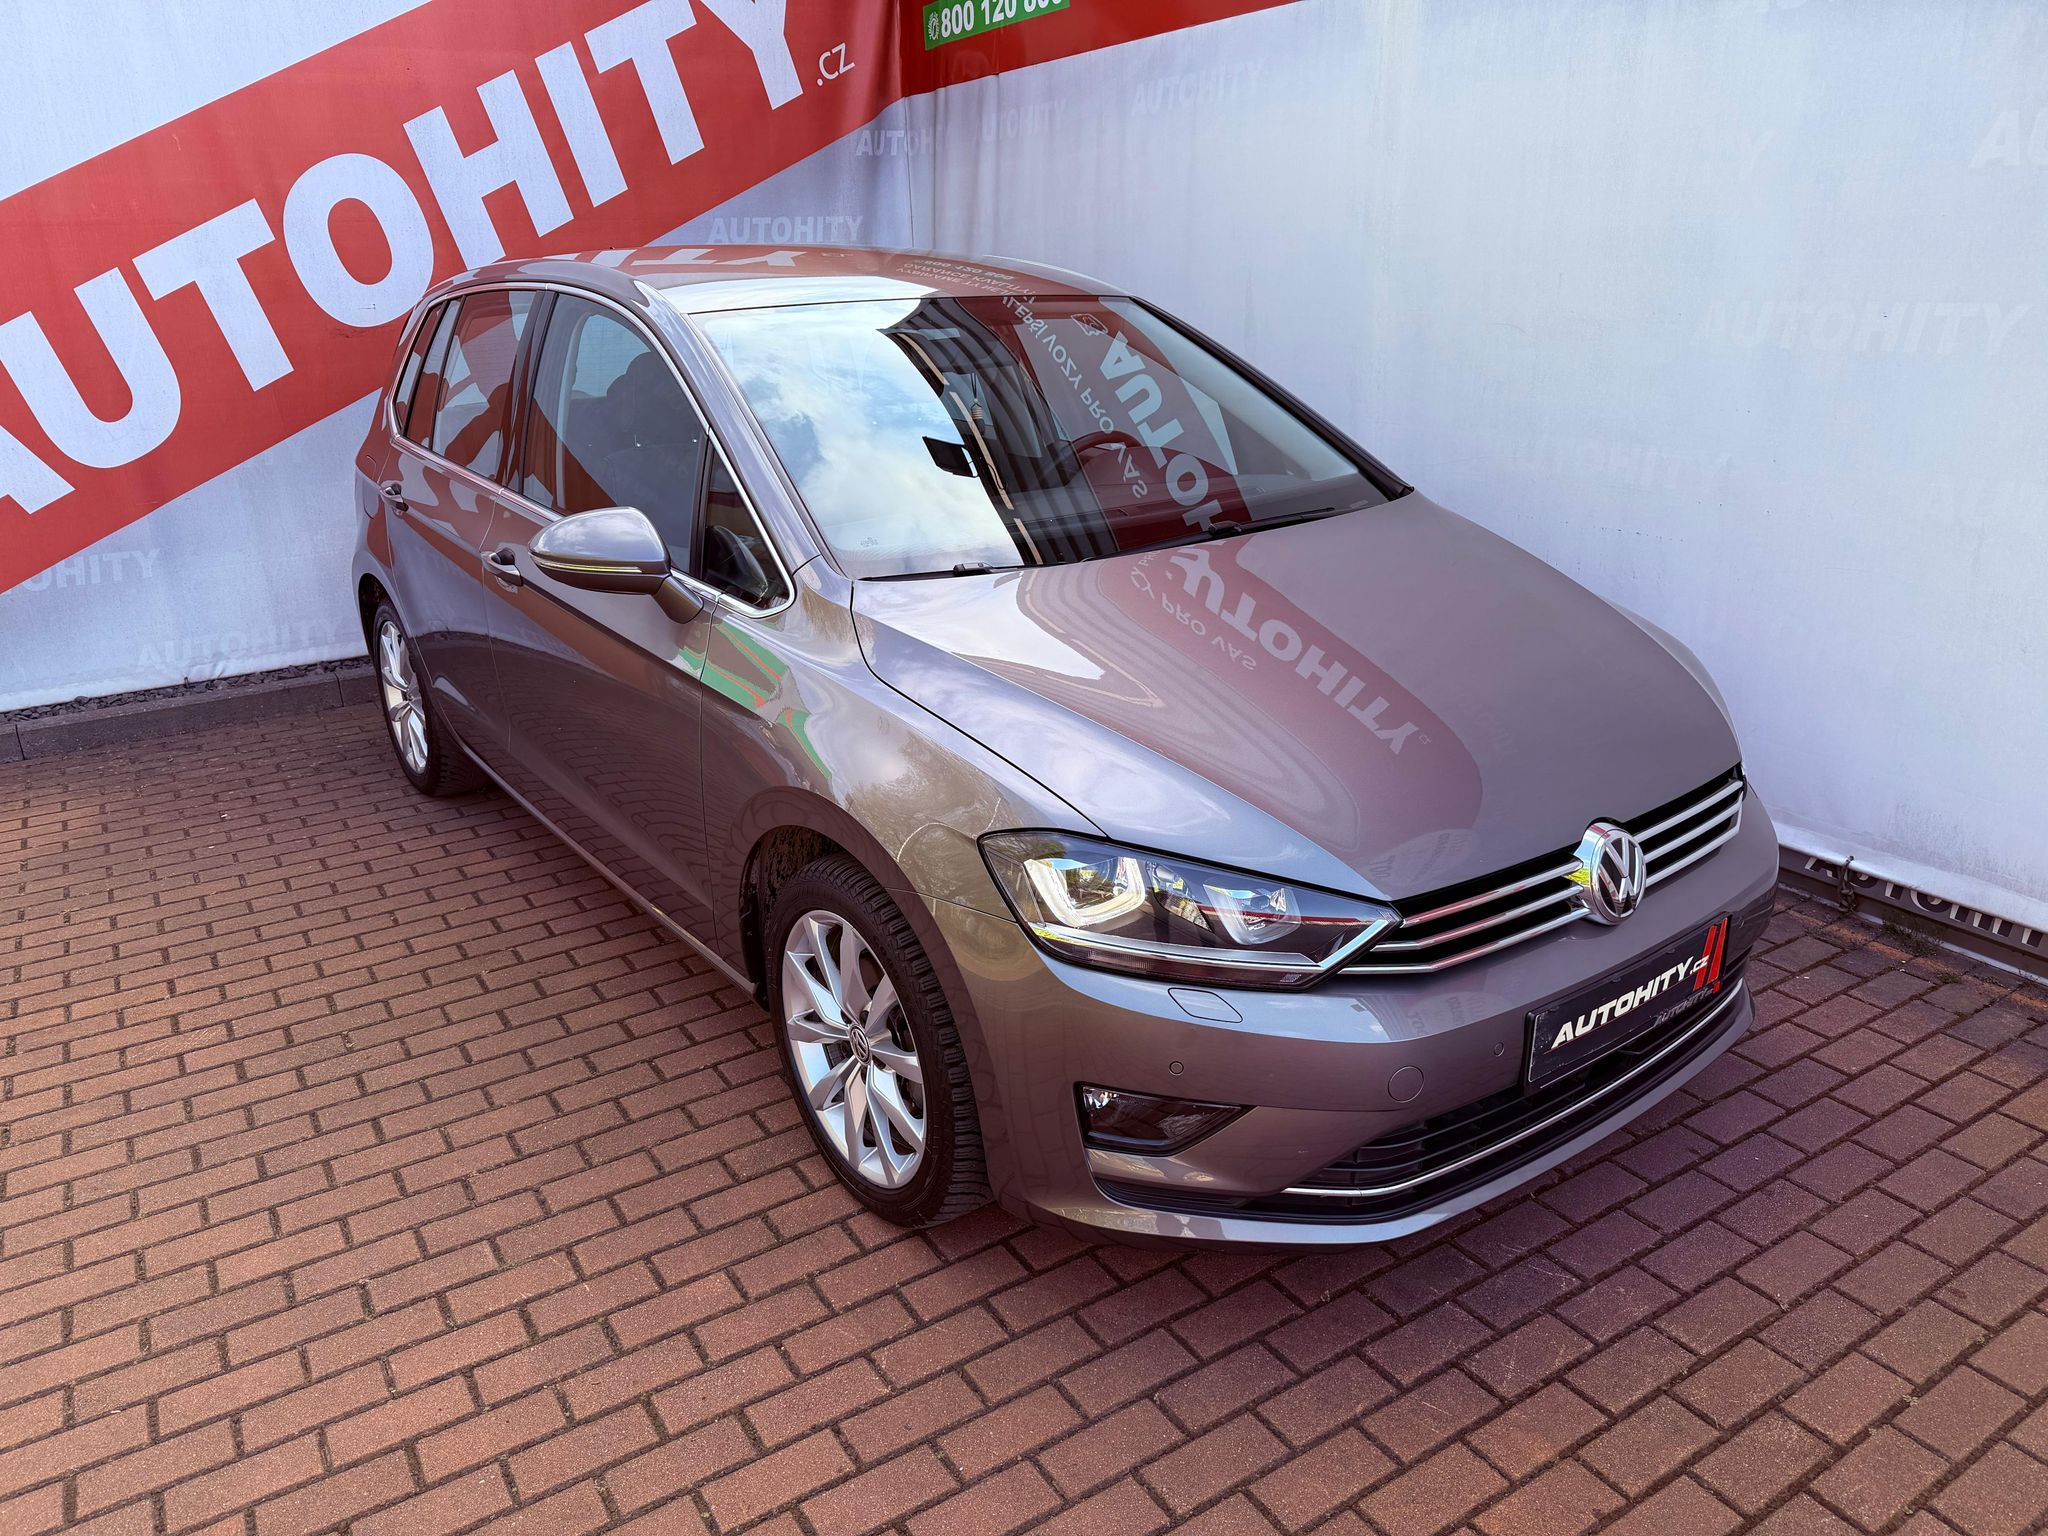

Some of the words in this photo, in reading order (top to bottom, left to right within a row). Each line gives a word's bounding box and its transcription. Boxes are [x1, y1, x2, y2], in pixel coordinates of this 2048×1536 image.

[941, 3, 975, 38] 800
[981, 0, 1017, 25] 120
[707, 215, 864, 244] AUTOHITY
[1693, 300, 2038, 357] AUTOHITY
